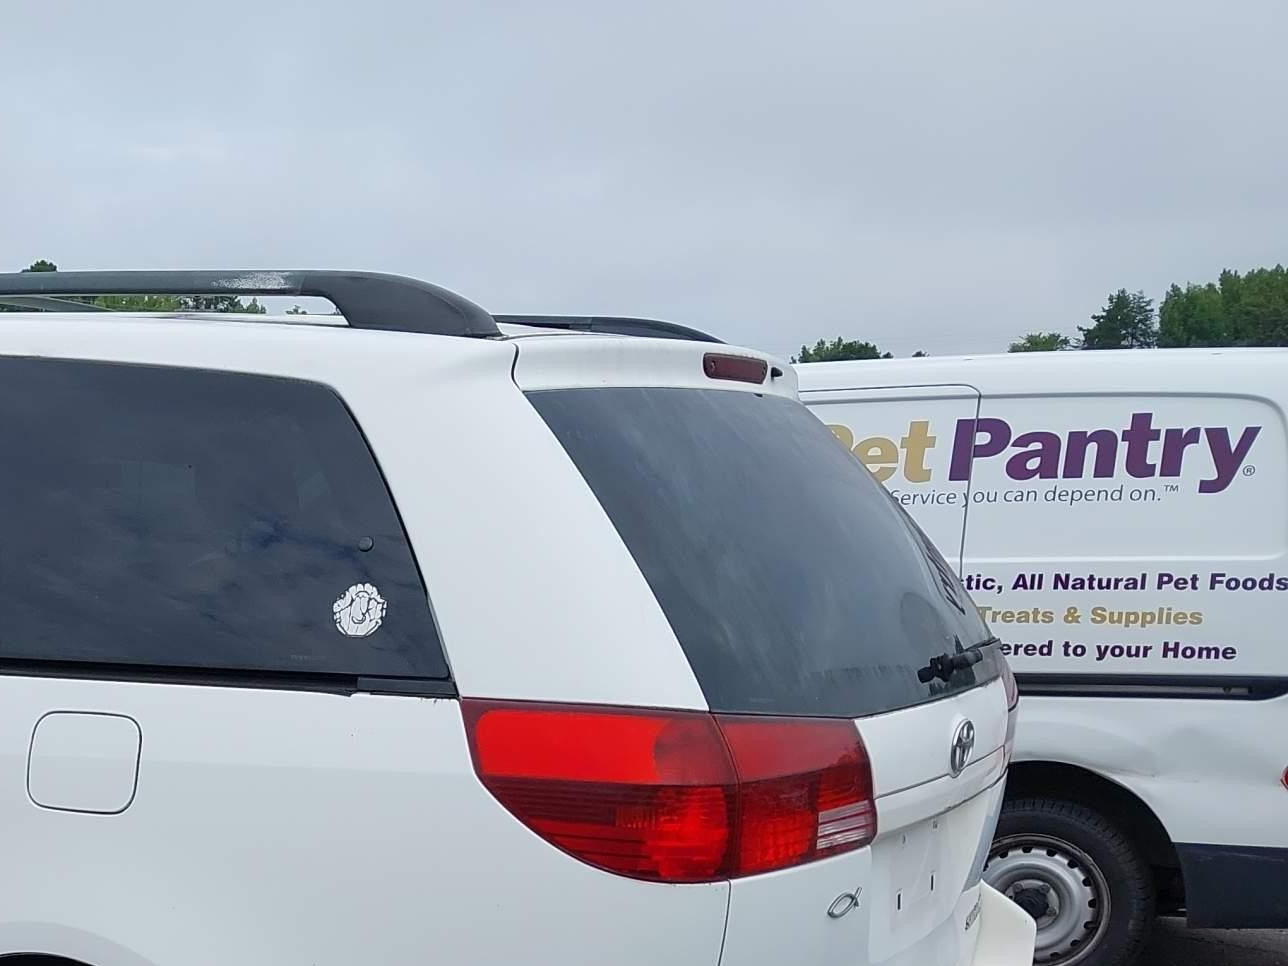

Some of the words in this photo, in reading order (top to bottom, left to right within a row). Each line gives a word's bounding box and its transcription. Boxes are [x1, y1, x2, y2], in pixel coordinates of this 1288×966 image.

[962, 489, 998, 507] you
[1004, 490, 1037, 503] can
[1045, 485, 1123, 506] depend
[1012, 573, 1044, 591] All
[1053, 572, 1147, 591] Natural
[1157, 572, 1199, 591] Pet
[1209, 572, 1288, 591] Foods
[976, 606, 1054, 624] Treats
[1063, 606, 1081, 624] &
[1090, 606, 1203, 628] Supplies
[1063, 641, 1087, 657] to
[1096, 645, 1153, 661] your
[1162, 641, 1237, 660] Home
